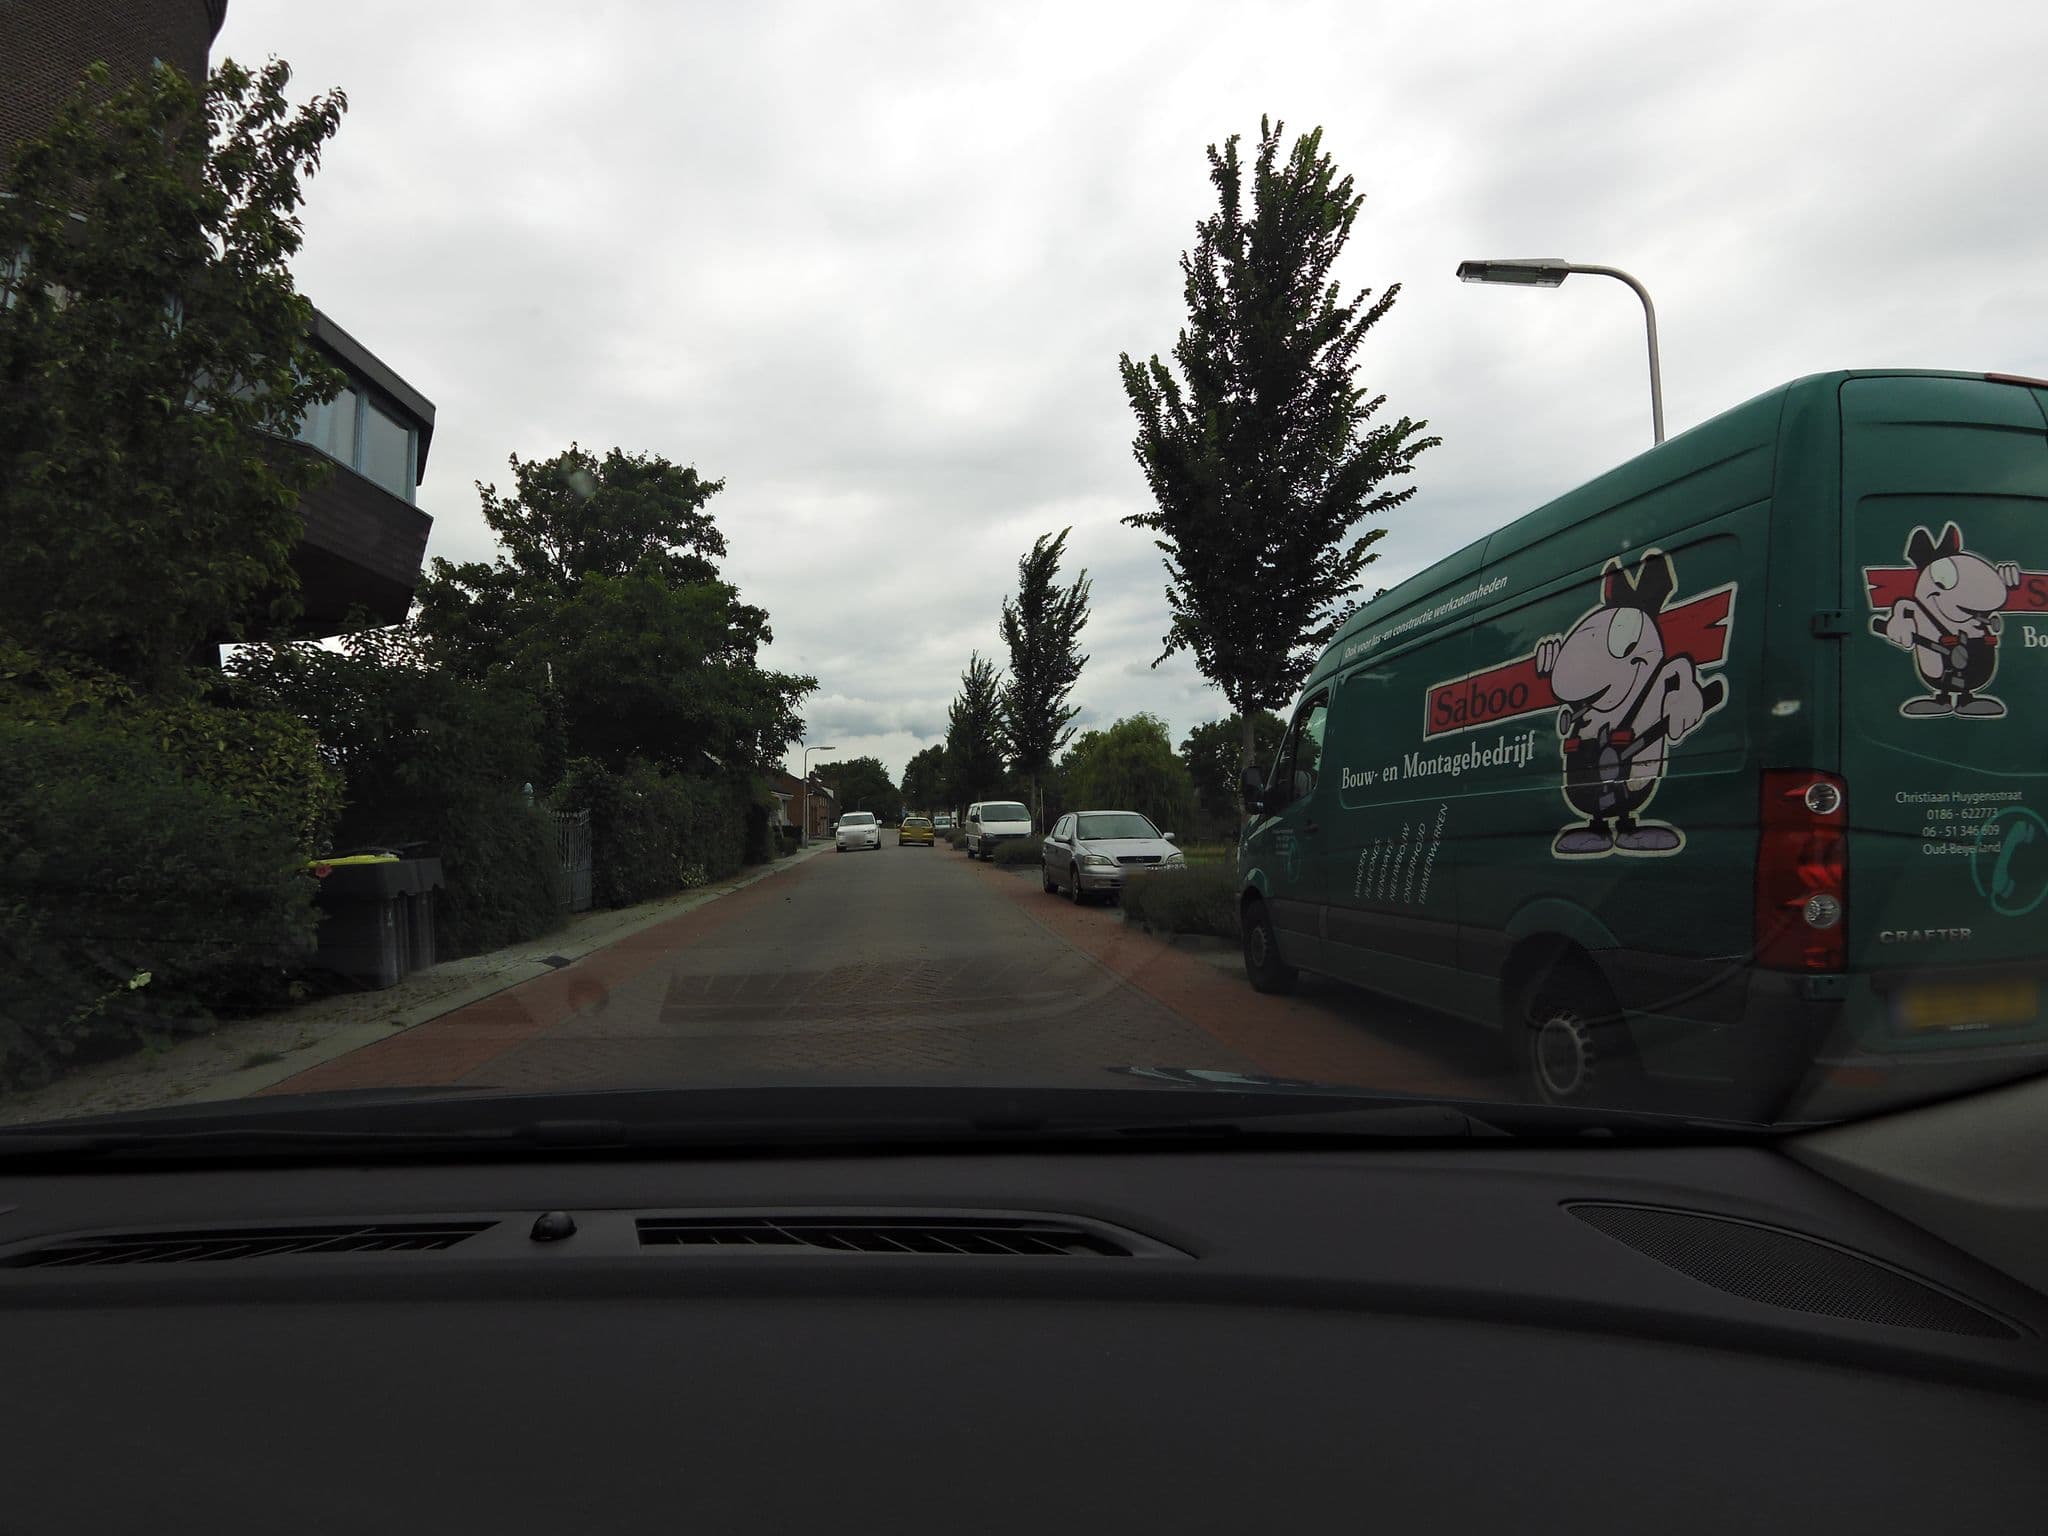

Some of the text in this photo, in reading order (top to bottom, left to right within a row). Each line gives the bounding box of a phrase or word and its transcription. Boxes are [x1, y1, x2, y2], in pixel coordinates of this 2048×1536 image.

[1393, 608, 1434, 635] constructie
[1433, 576, 1508, 618] werkzaamheden
[1435, 682, 1528, 726] Saboo
[1342, 730, 1536, 789] Bouw- en Montagebedrijf
[1895, 791, 2023, 804] Christiaan Huygensstraat
[1926, 808, 1953, 820] 0186
[1961, 807, 1998, 819] 622773
[1418, 803, 1448, 904] TIMMERWERKEN
[1922, 826, 1937, 838] 06
[1945, 825, 1957, 837] 51
[1389, 822, 1410, 901] NIEUWBOUW
[1403, 822, 1426, 904] ONDERHOUD
[1880, 928, 1972, 944] CRAFTER
